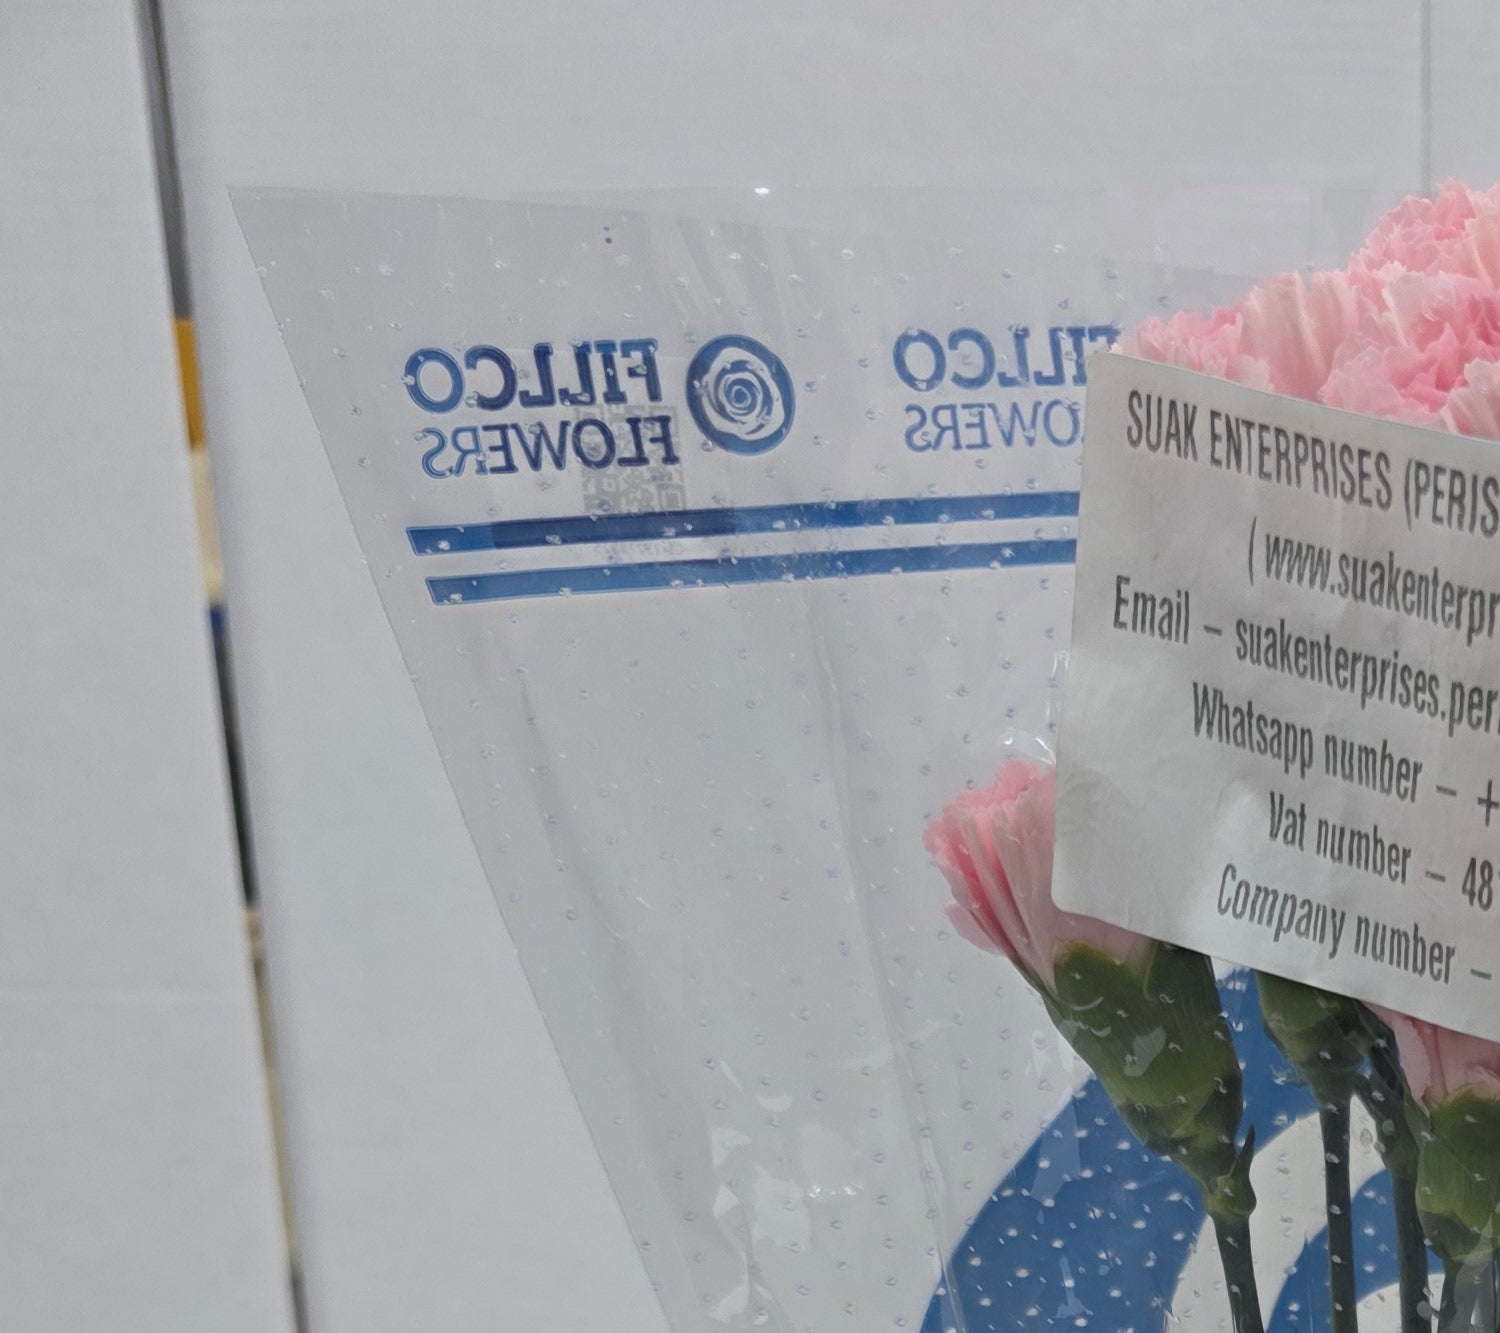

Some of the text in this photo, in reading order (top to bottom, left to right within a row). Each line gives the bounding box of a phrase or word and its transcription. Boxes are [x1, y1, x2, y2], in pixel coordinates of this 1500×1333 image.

[1126, 389, 1199, 462] SUAK
[1210, 409, 1393, 511] ENTERPRISES
[1112, 574, 1190, 645] Email
[1192, 681, 1314, 780] Whatsapp
[1325, 738, 1423, 803] number
[1269, 791, 1307, 851] Vat
[1316, 817, 1411, 885] number
[1217, 863, 1346, 959] Company
[1354, 914, 1456, 985] number
